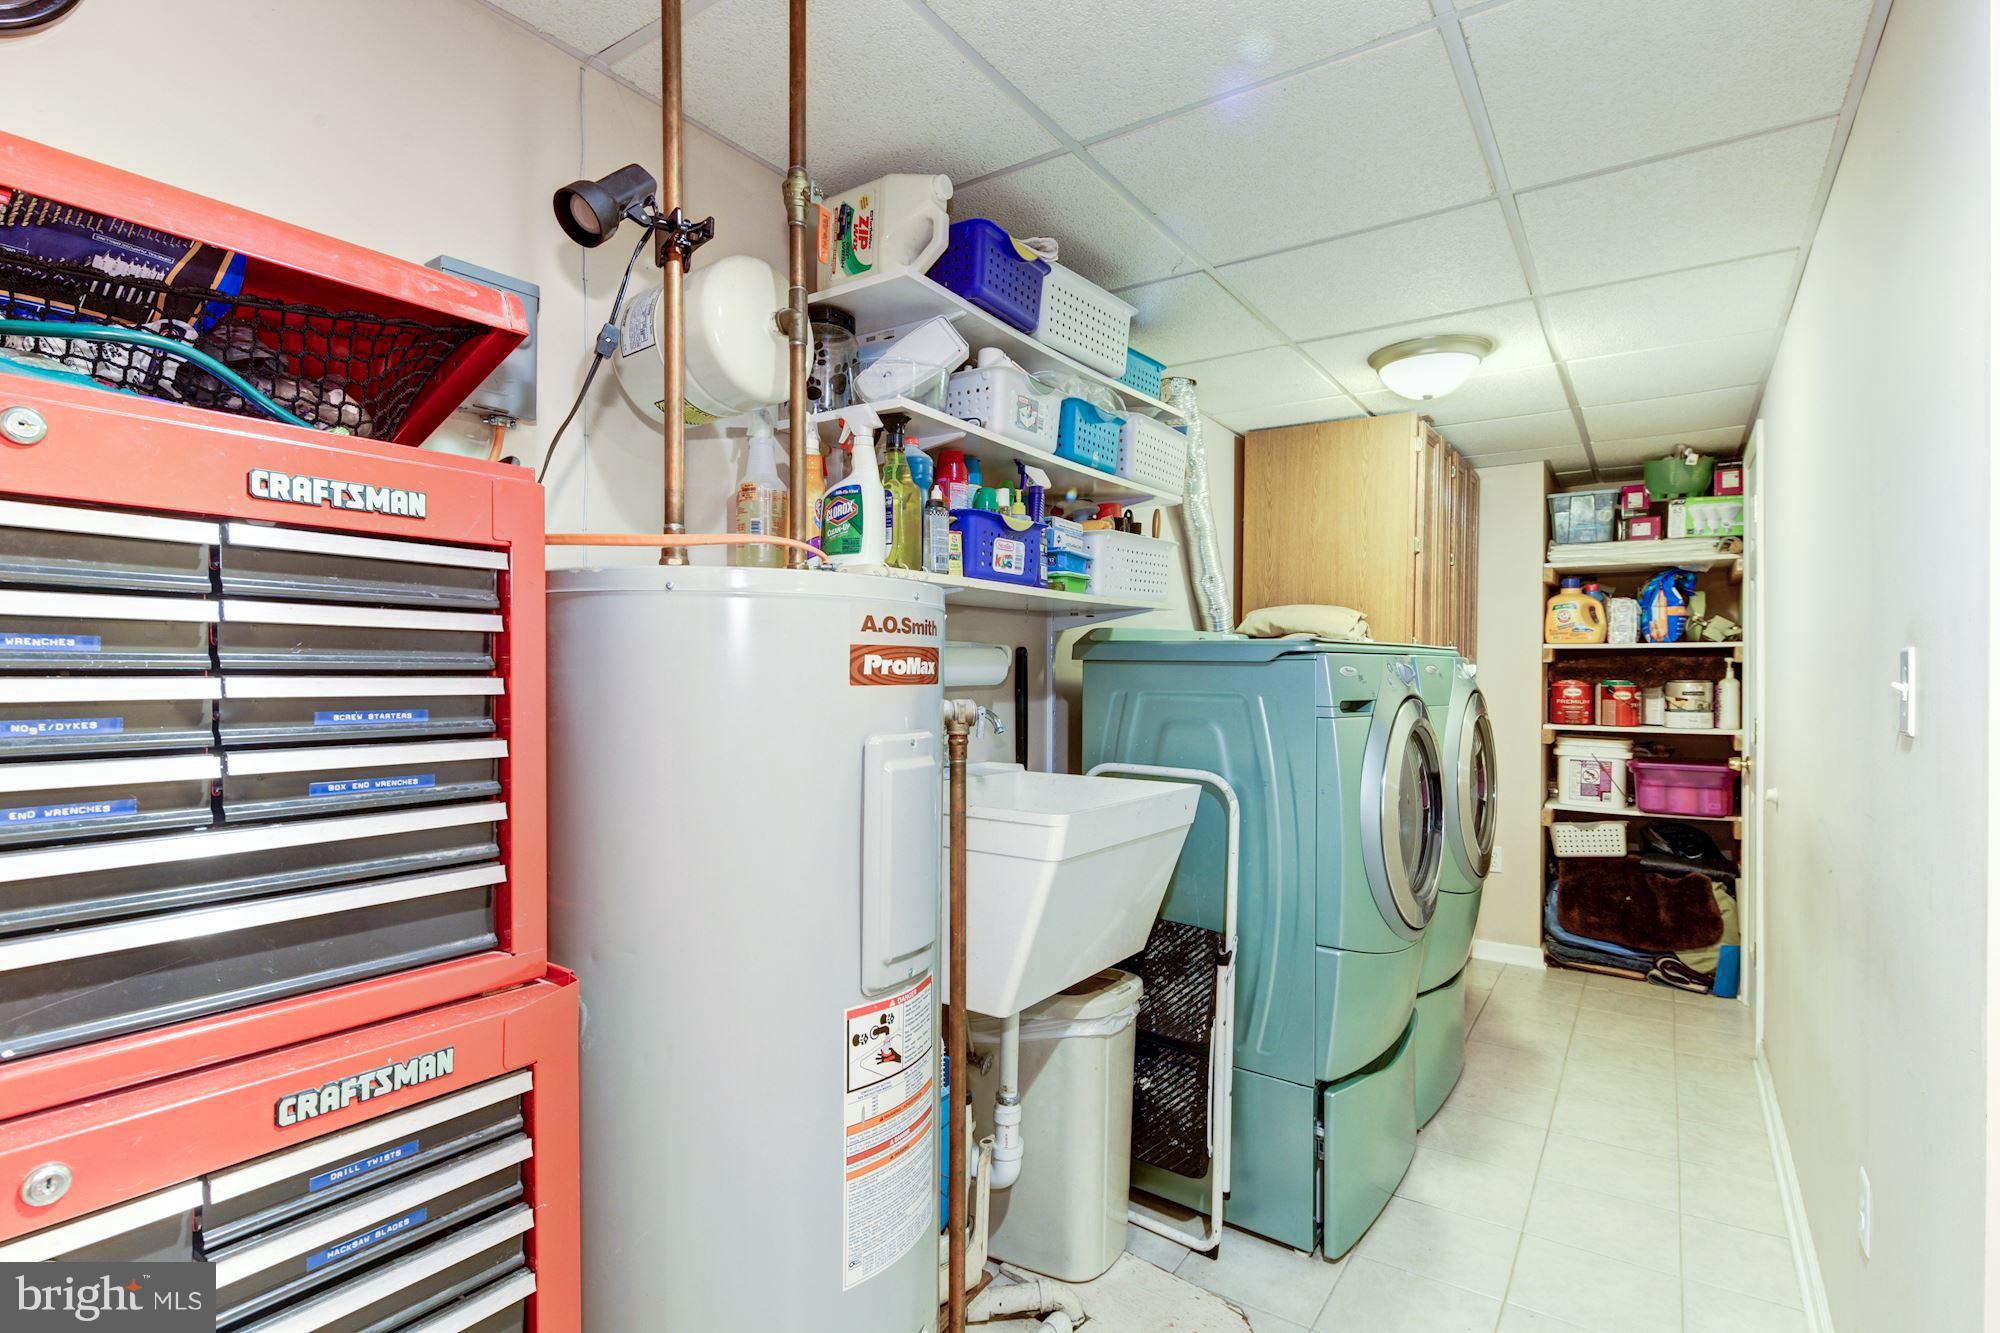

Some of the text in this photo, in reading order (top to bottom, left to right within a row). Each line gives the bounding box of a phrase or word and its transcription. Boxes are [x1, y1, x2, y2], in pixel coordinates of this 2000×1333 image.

[858, 216, 870, 250] ZIP
[249, 469, 428, 519] CRAFTSMAN
[826, 498, 855, 521] CLOROX
[5, 637, 76, 647] WRENCHES
[863, 654, 936, 676] ProMax
[333, 712, 413, 721] SCREW STARTERS
[327, 778, 419, 792] BOX END WRENCHES
[9, 804, 111, 821] END WRENCHES
[896, 988, 917, 1005] DANGER
[274, 1047, 455, 1130] CRAFTSMAN
[329, 1149, 402, 1181] DRILL TWISTS
[326, 1218, 410, 1260] HACKSAW BLADES
